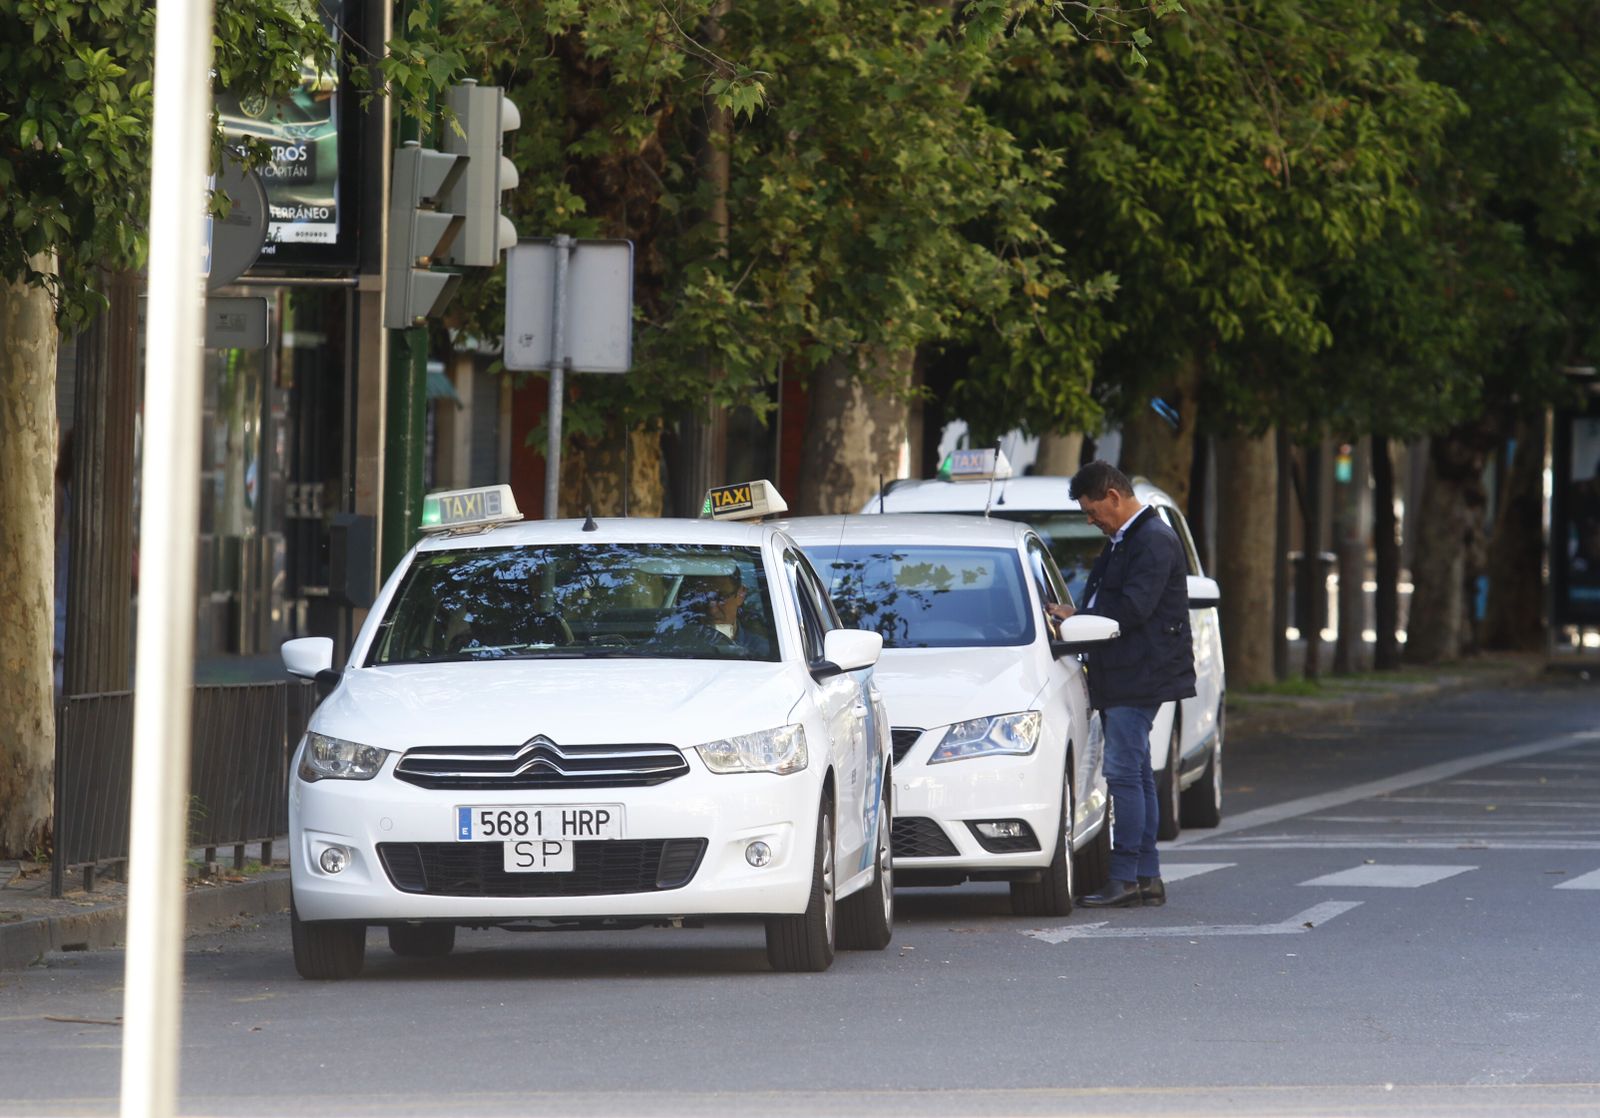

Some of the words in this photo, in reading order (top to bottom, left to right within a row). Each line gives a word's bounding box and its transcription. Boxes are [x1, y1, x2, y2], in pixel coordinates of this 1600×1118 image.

[262, 146, 307, 161] TROS
[264, 164, 308, 177] CAPITÁN
[269, 204, 329, 219] TERRÁNEO
[442, 493, 484, 519] TAXI
[712, 486, 751, 507] TAXI
[462, 827, 469, 835] E
[480, 810, 543, 836] 5681
[561, 809, 611, 836] HRP
[514, 840, 563, 868] SP
